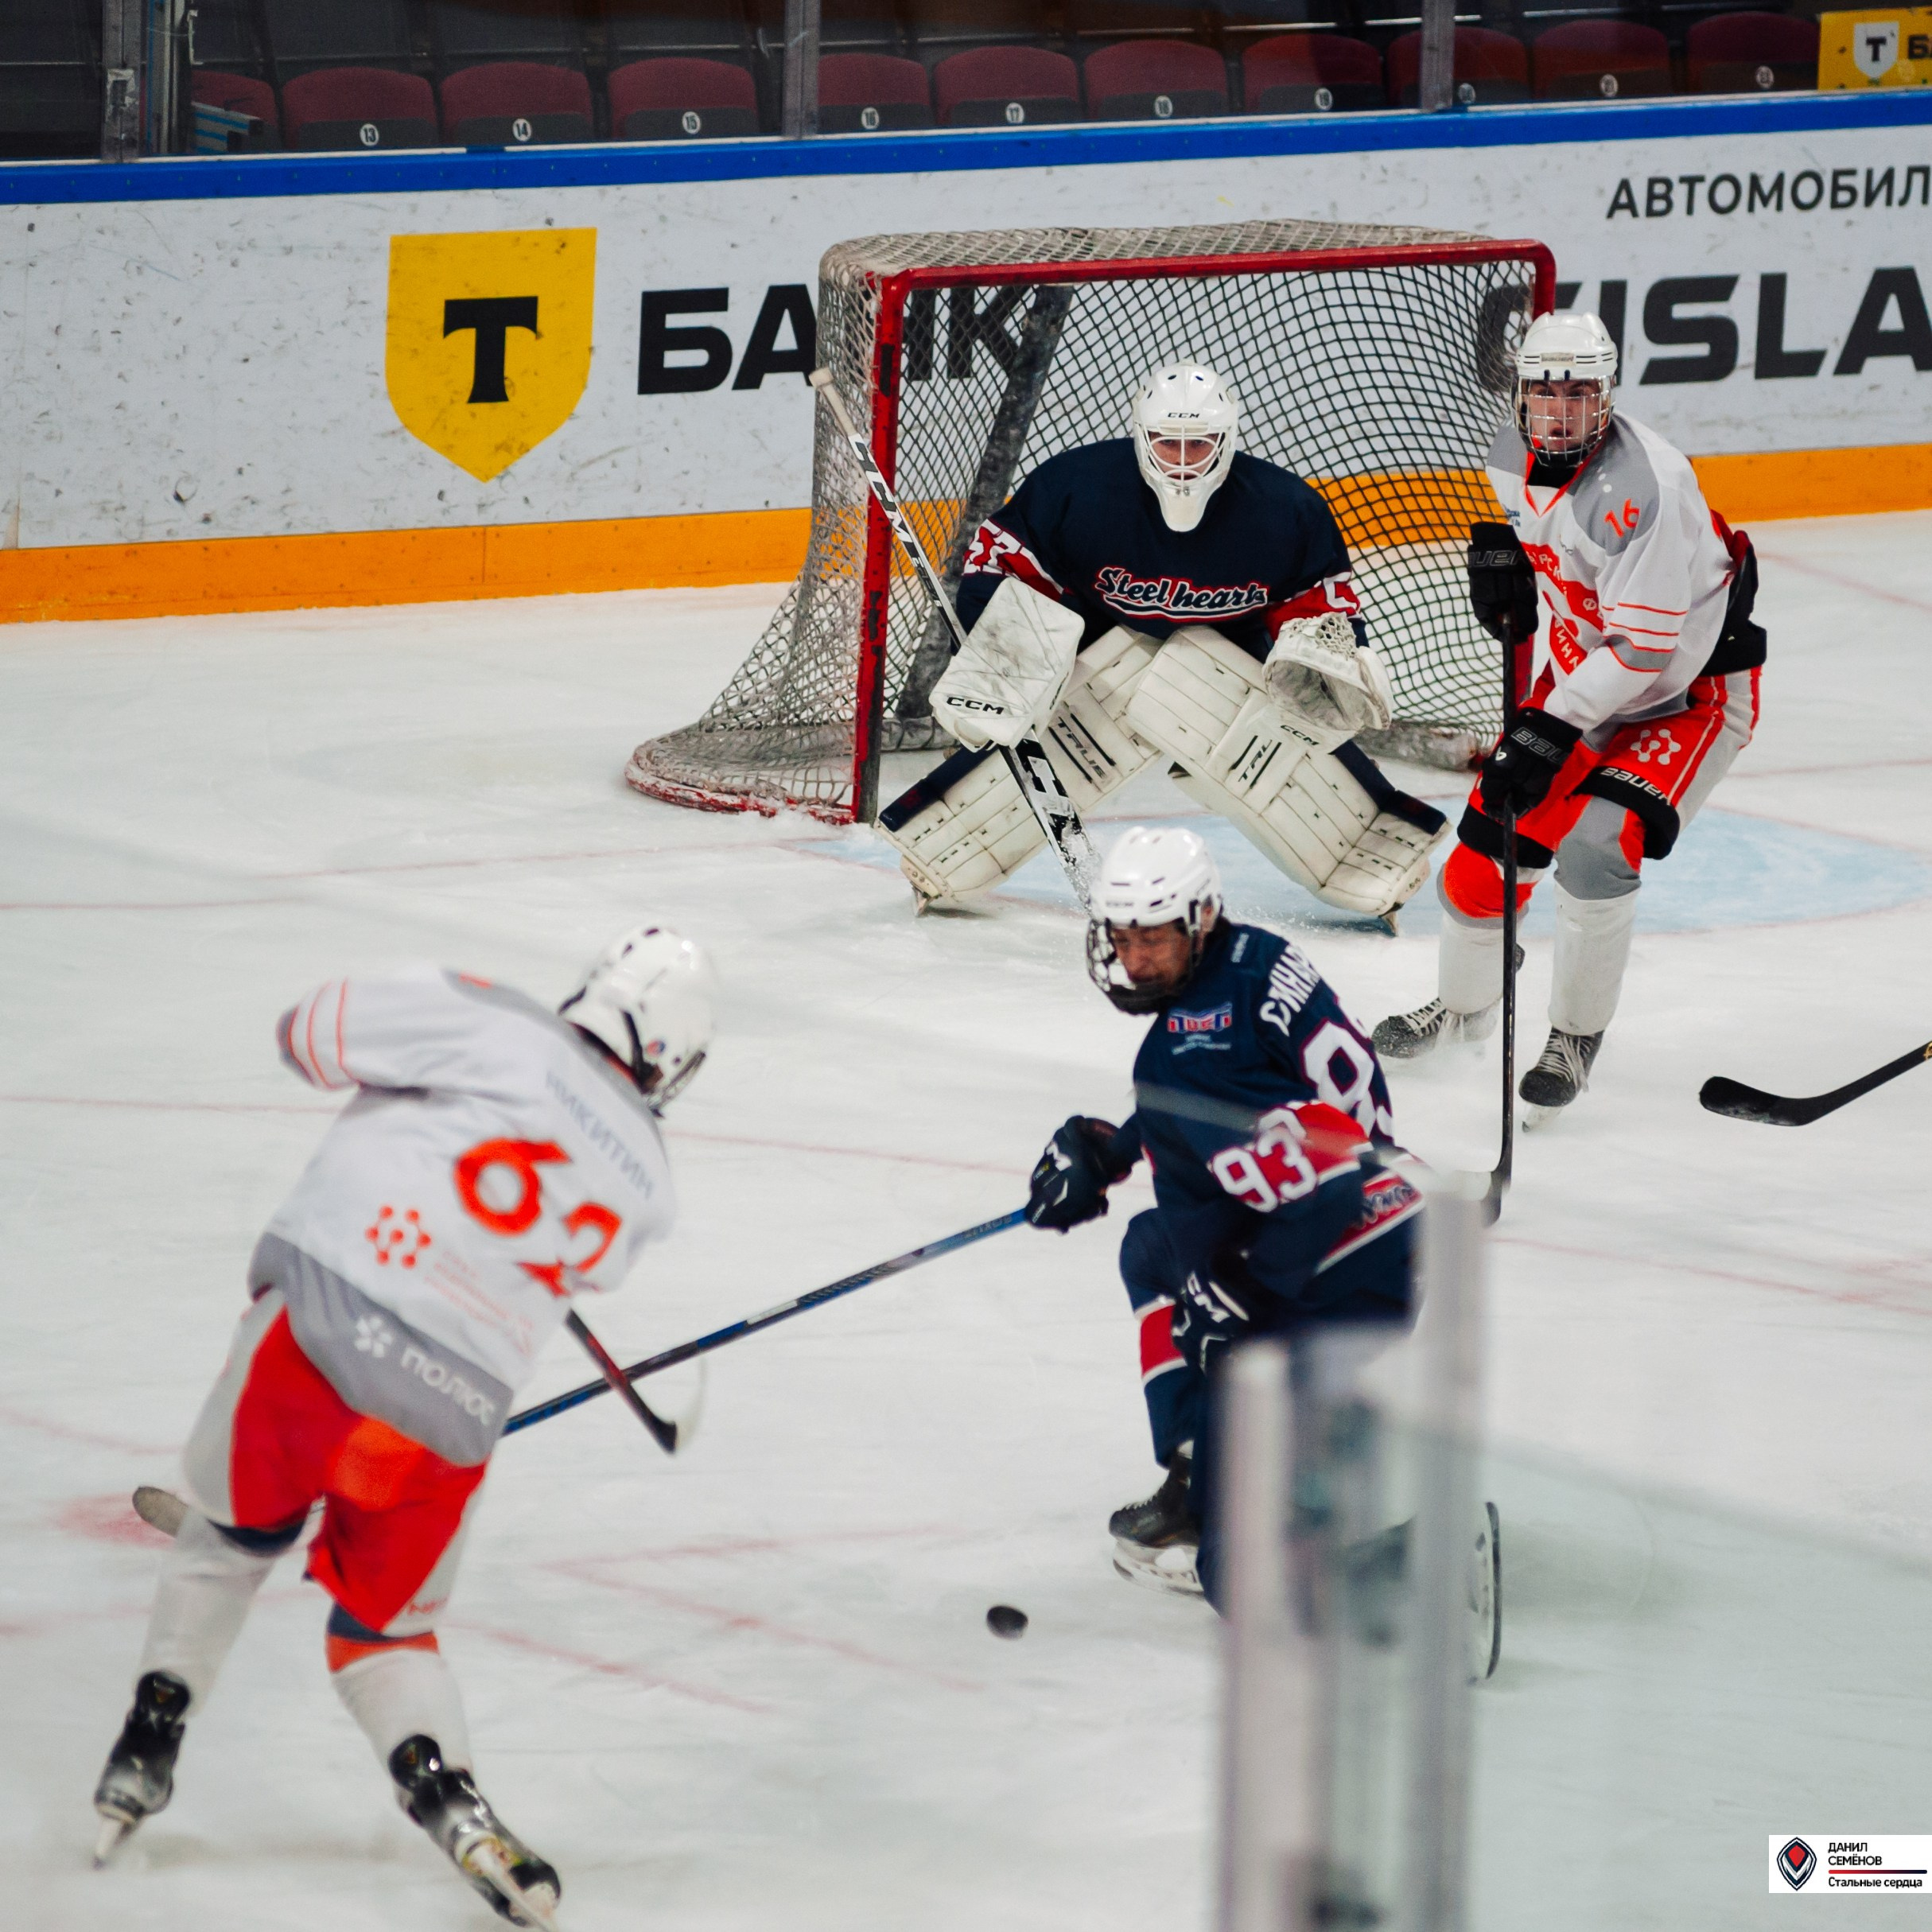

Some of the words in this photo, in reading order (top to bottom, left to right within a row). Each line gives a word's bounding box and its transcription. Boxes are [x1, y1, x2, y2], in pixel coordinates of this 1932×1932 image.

[1907, 33, 1932, 60] Б
[1606, 165, 1931, 219] АВТОМОБИЛ
[443, 296, 538, 403] Т
[1604, 499, 1640, 538] 16
[1095, 567, 1172, 604] Steel
[1169, 581, 1268, 610] hearts
[947, 696, 1005, 715] CCM
[1057, 716, 1109, 779] TRUE
[1280, 725, 1320, 746] CCM
[1211, 1107, 1318, 1214] 93
